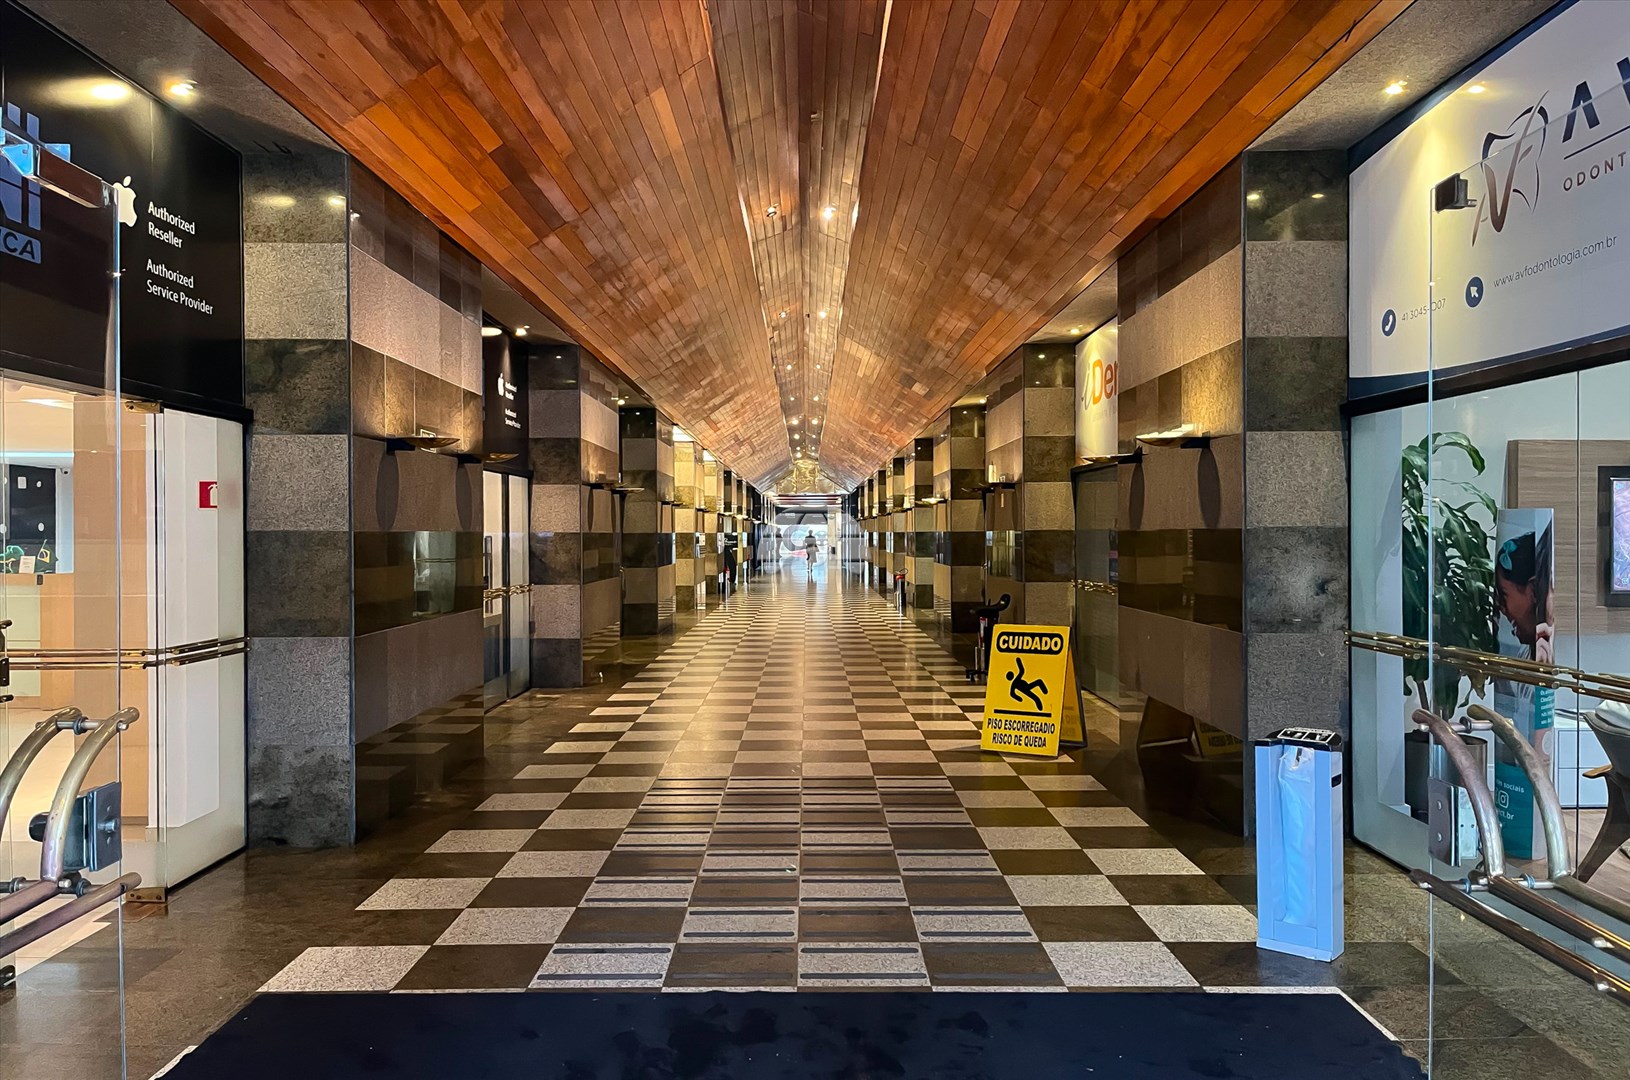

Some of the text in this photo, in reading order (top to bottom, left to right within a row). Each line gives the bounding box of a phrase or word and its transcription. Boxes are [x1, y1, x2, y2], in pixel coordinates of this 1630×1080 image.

[1563, 152, 1627, 191] ODONT
[148, 201, 195, 235] Authorized
[0, 229, 36, 260] CA
[148, 222, 183, 248] Reseller
[146, 258, 194, 288] Authorized
[1493, 235, 1617, 288] www.avfodontologia.com.br
[146, 279, 213, 315] Service Provider
[999, 635, 1061, 651] CUIDADO
[987, 718, 1002, 730] PISO
[1004, 719, 1056, 734] ESCORREGADIO
[992, 733, 1047, 748] RISCO DE QUEDA
[1503, 782, 1525, 793] sociais
